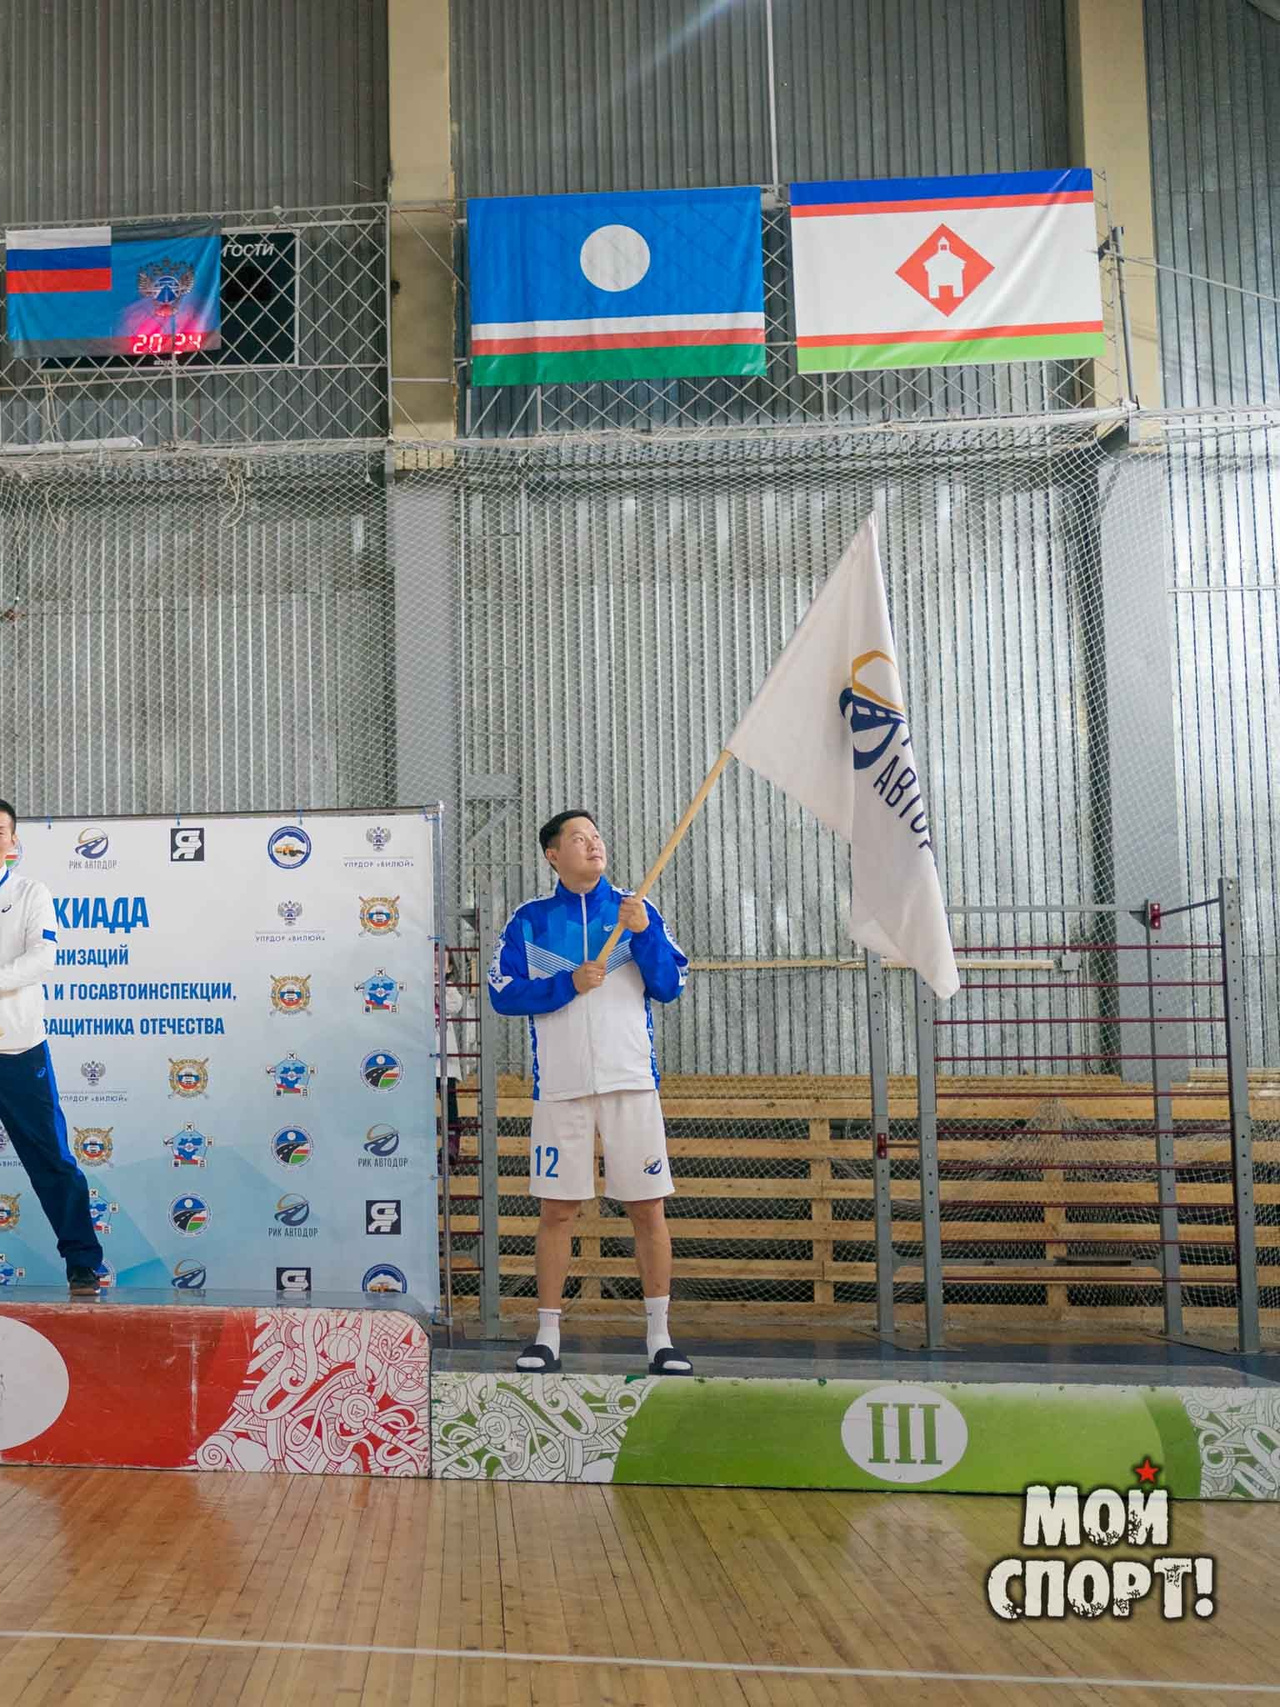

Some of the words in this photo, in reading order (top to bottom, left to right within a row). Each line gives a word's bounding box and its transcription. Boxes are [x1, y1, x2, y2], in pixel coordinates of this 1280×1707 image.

[223, 243, 275, 258] ГОСТИ
[53, 896, 150, 934] КИАДА
[55, 944, 129, 968] НИЗАЦИЙ
[54, 984, 64, 1001] И
[70, 982, 237, 1002] ГОСАВТОИНСПЕКЦИИ,
[140, 1017, 225, 1036] ОТЕЧЕСТВА
[535, 1145, 559, 1178] 12
[866, 1402, 943, 1465] III
